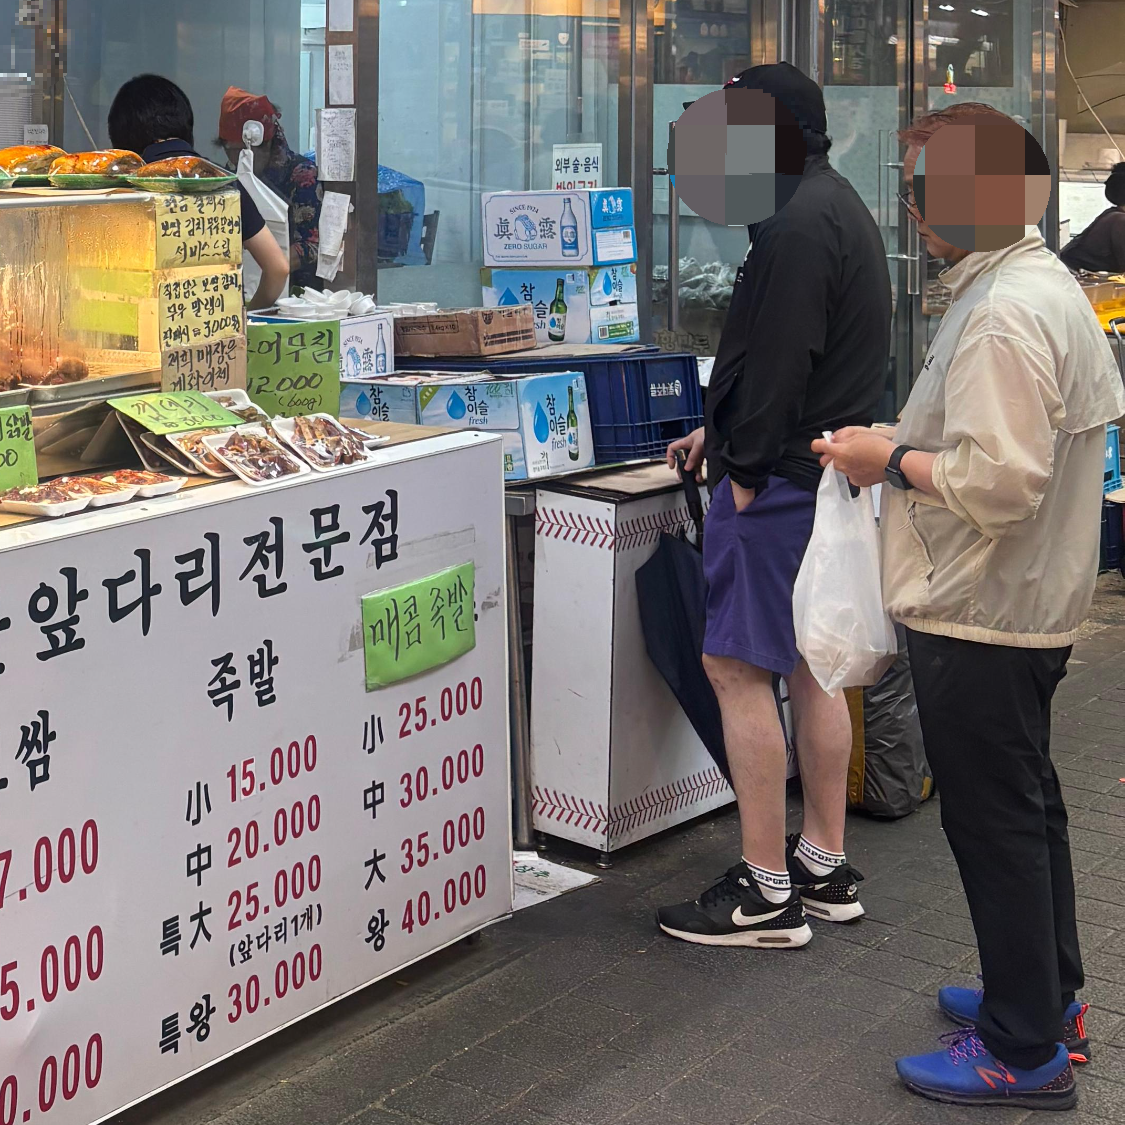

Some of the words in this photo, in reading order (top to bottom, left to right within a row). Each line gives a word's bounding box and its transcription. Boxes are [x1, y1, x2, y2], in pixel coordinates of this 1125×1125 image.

[555, 157, 570, 174] 외부
[247, 329, 334, 365] 어무침
[468, 416, 488, 426] fresh
[551, 436, 567, 451] fresh
[369, 595, 422, 662] 매콤
[206, 638, 281, 723] 족발
[362, 714, 384, 754] 小
[397, 675, 483, 739] 25.000
[185, 781, 212, 826] 小
[226, 733, 318, 804] 15.000
[363, 779, 386, 819] 中
[399, 743, 485, 809] 30.000
[186, 842, 213, 888] 中
[226, 793, 322, 869] 20.000
[363, 848, 387, 891] 大
[399, 806, 486, 875] 35.000
[227, 853, 322, 932] 25.000
[364, 907, 390, 953] 왕
[400, 864, 487, 935] 40.000
[227, 943, 324, 1024] 30.000
